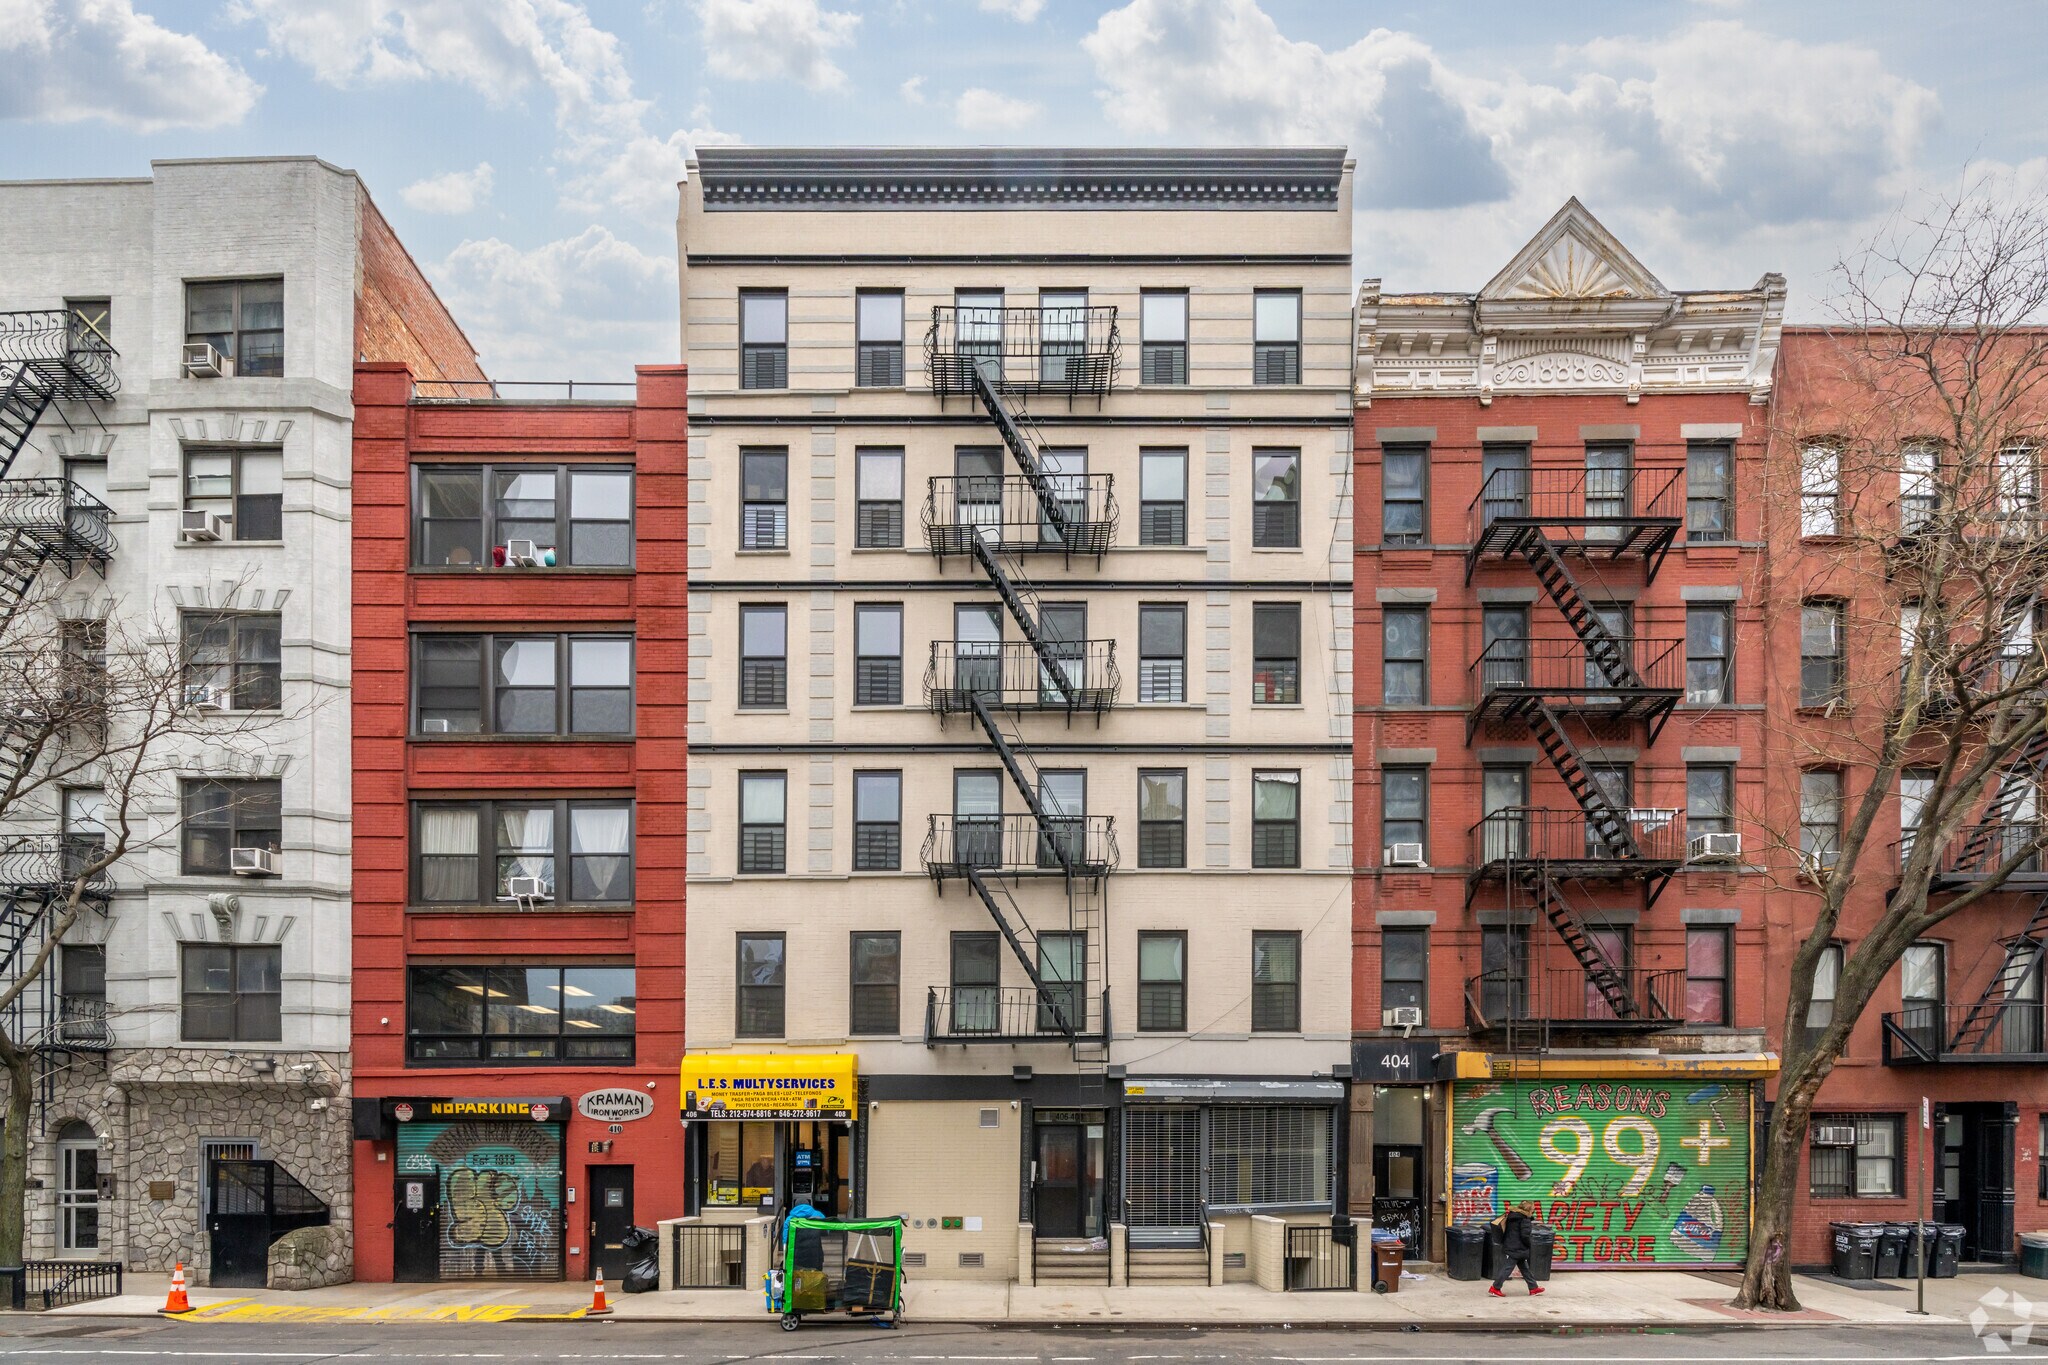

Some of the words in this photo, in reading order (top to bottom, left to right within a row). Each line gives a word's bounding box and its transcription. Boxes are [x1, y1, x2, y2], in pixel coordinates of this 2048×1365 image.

[1530, 356, 1586, 383] 1888
[1381, 1055, 1410, 1068] 404
[698, 1078, 730, 1089] L.E.S.
[733, 1078, 835, 1089] MULTYSERVICES
[587, 1093, 644, 1113] KRAMAN
[1528, 1083, 1671, 1119] REASONS
[591, 1108, 610, 1116] IRON
[612, 1108, 640, 1116] WORKS
[710, 1110, 728, 1118] TELS:
[729, 1110, 772, 1118] 212-674-6816
[779, 1110, 822, 1118] 646-272-9617
[484, 1121, 515, 1143] IRON
[608, 1125, 622, 1133] 410
[1503, 1200, 1645, 1232] ARIETY
[1551, 1235, 1656, 1263] STORE
